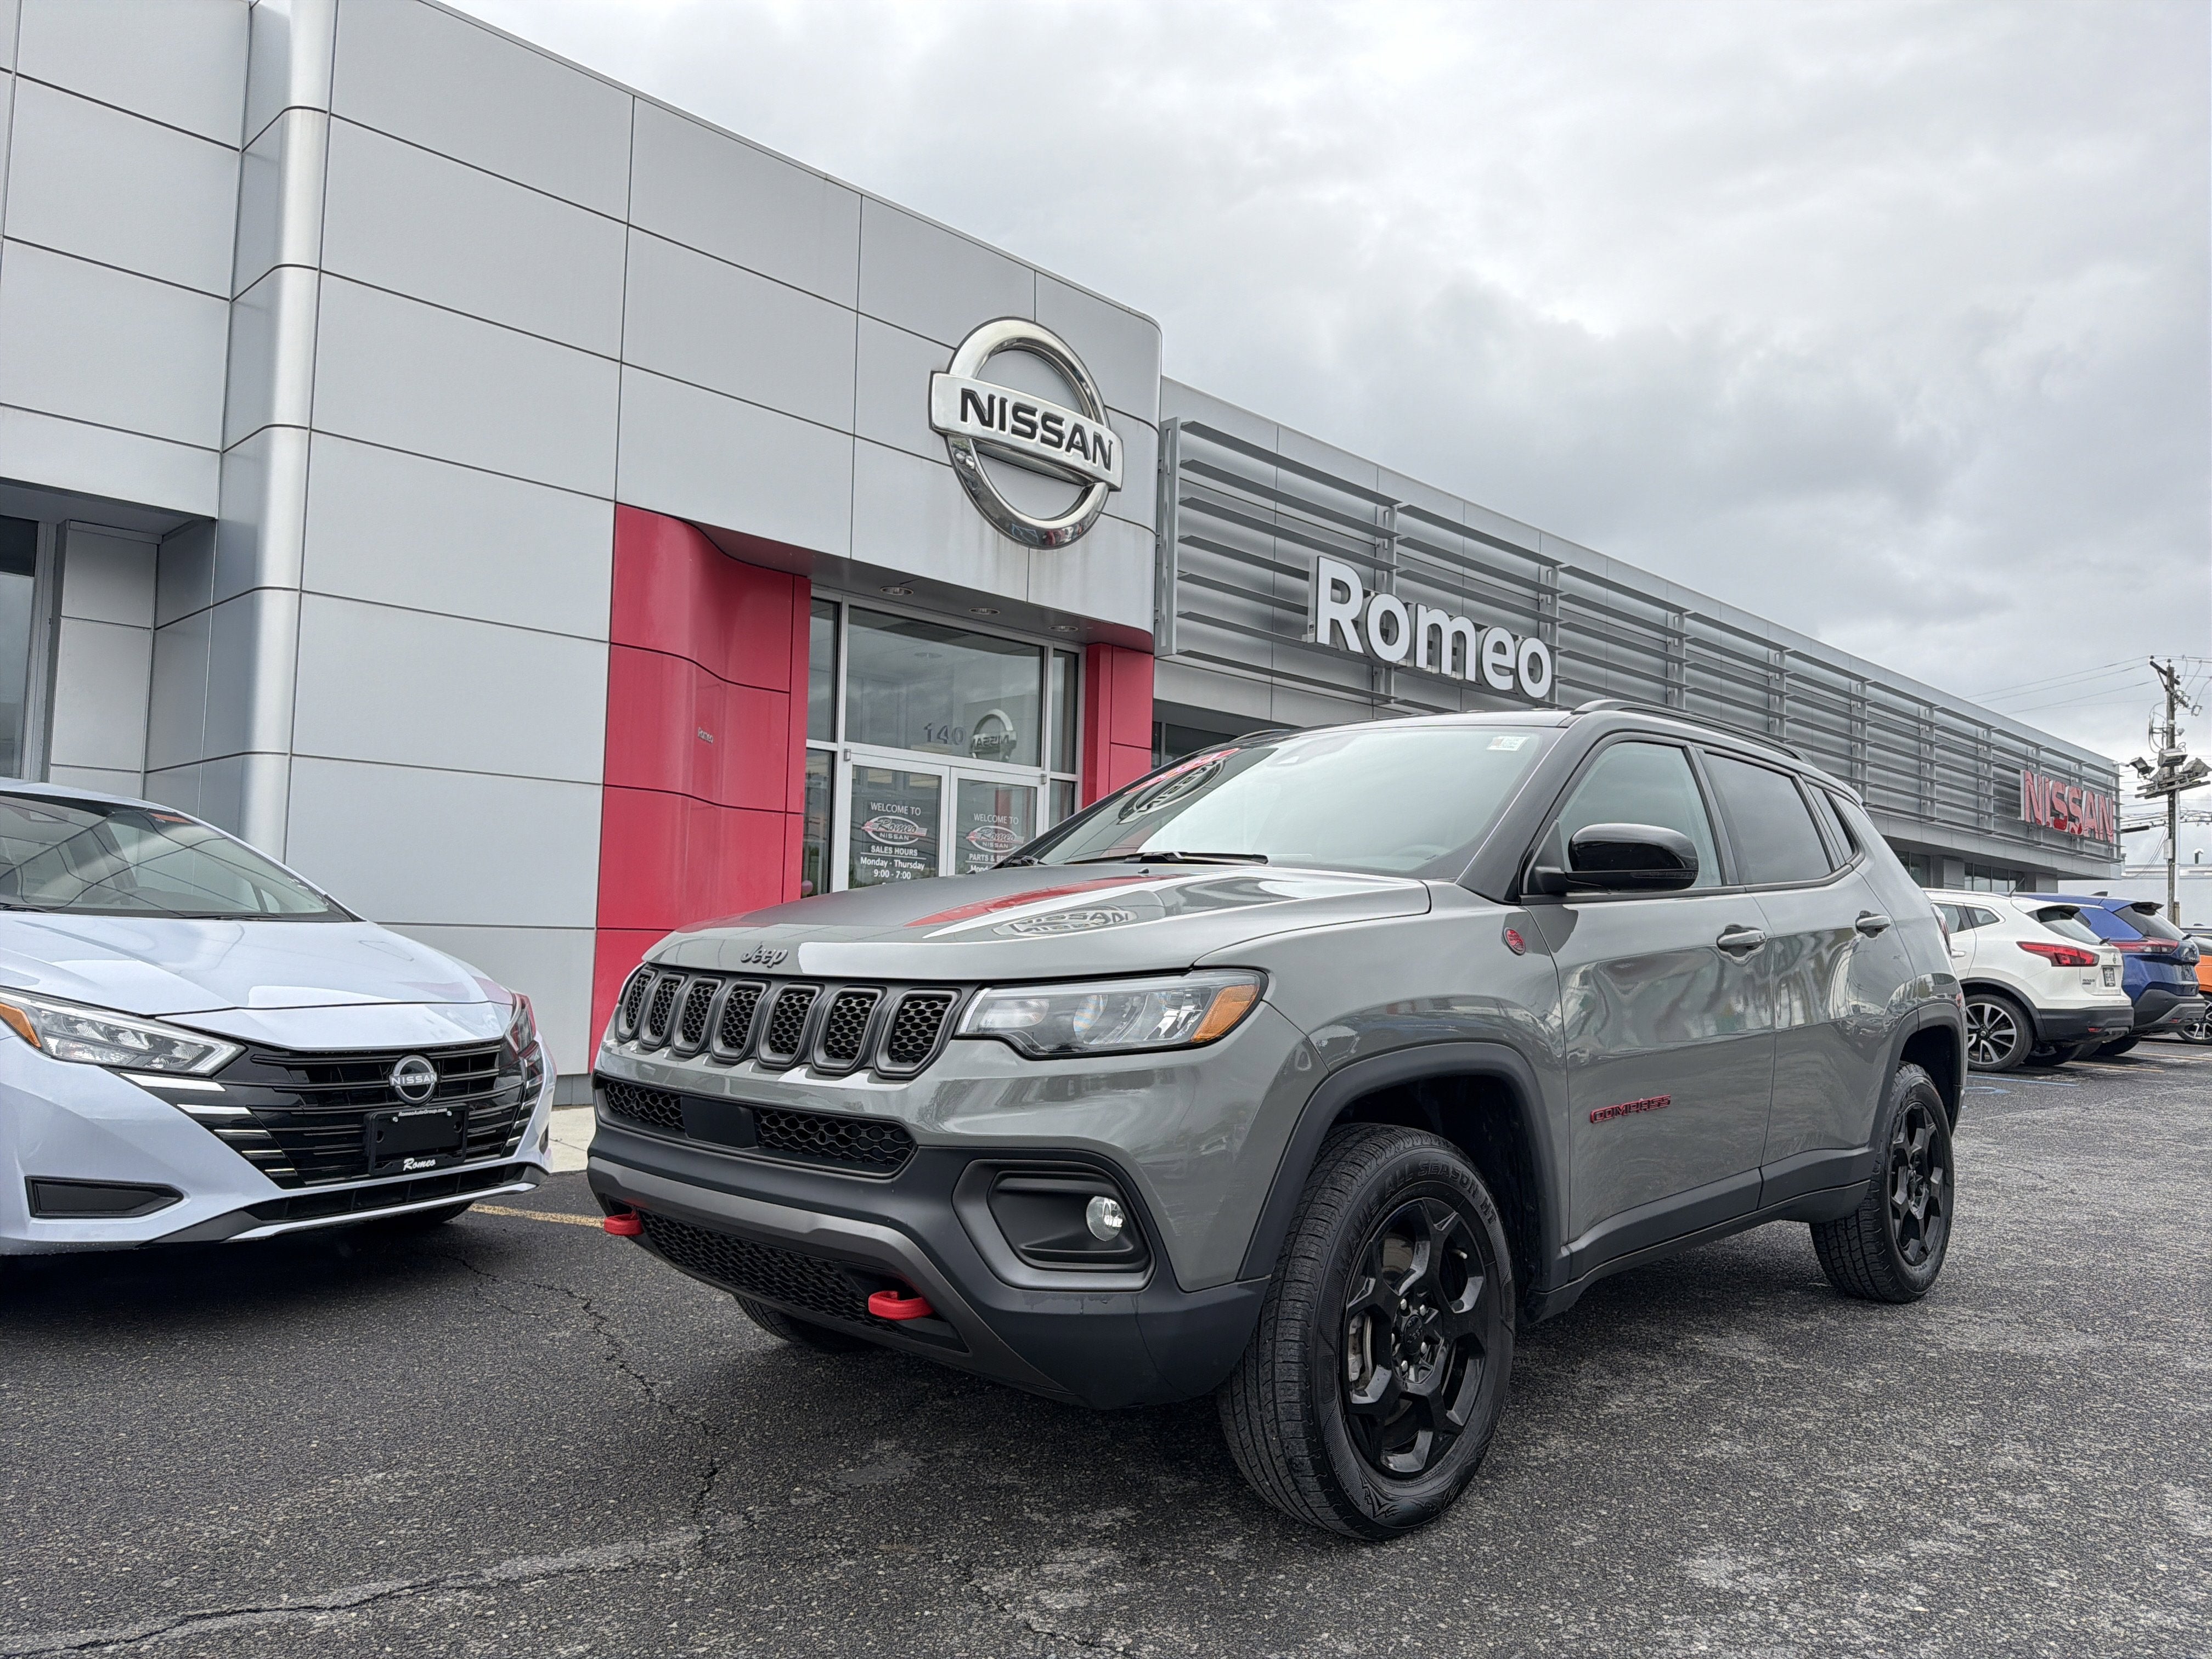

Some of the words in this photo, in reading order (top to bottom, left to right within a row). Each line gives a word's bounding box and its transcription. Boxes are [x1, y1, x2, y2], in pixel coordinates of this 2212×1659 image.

[960, 387, 1113, 472] NISSAN
[1316, 555, 1553, 699] Romeo
[924, 723, 967, 746] 140
[871, 802, 909, 815] WELCOME
[910, 806, 921, 816] TO
[2020, 769, 2114, 843] NISSAN
[874, 817, 917, 833] Romeo
[974, 813, 1007, 824] WELCOME
[1009, 816, 1019, 825] TO
[879, 832, 909, 840] NISSAN
[977, 827, 1015, 841] Romeo
[871, 845, 893, 854] SALES
[894, 847, 918, 856] HOURS
[969, 853, 989, 862] PARTS
[860, 856, 888, 868] Monday
[894, 859, 925, 871] Thursday
[970, 865, 989, 873] Mond
[873, 869, 889, 878] 9:00
[896, 871, 911, 879] 7:00
[741, 941, 788, 968] Jeep
[391, 1074, 437, 1085] NISSAN
[398, 1108, 447, 1117] RomeoAutoGroup.com
[1590, 1094, 1671, 1123] COMPASS
[403, 1158, 436, 1171] Romeo
[1383, 1163, 1414, 1200] ALL
[1418, 1159, 1479, 1199] SEASON
[1480, 1196, 1497, 1225] HT
